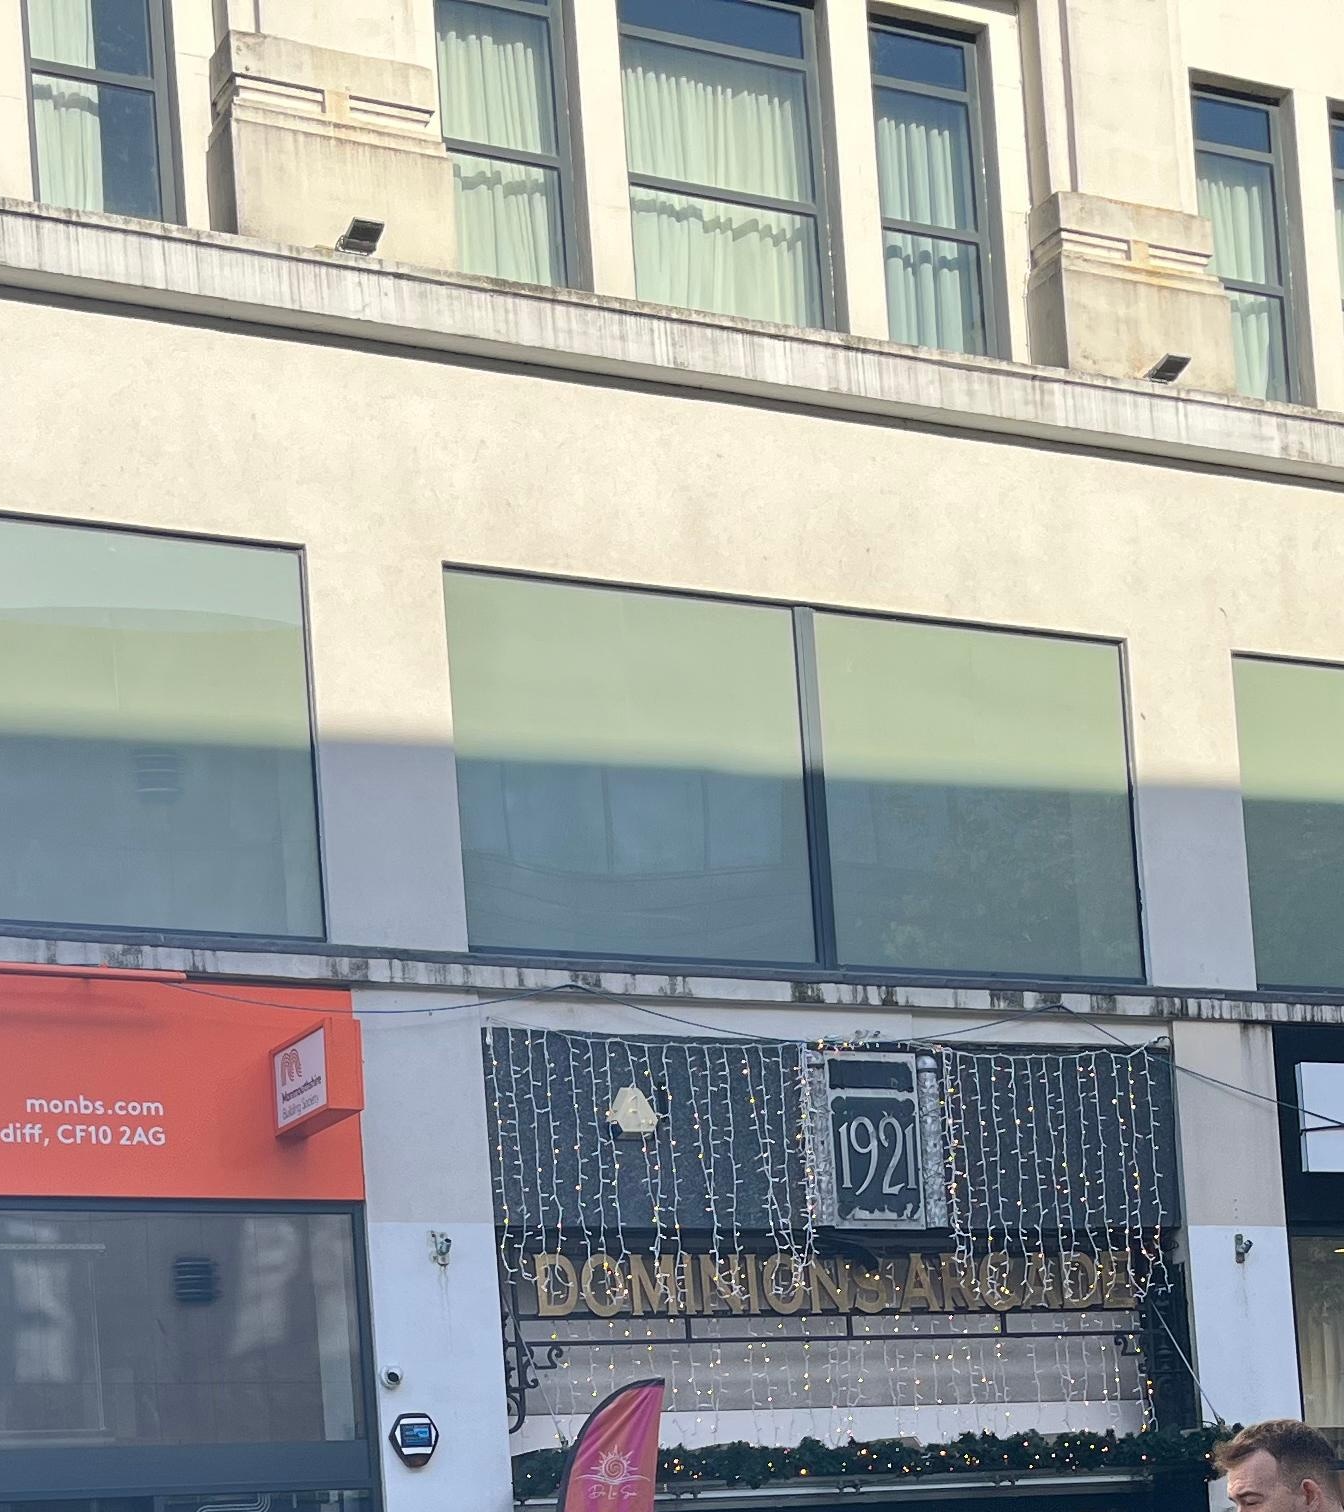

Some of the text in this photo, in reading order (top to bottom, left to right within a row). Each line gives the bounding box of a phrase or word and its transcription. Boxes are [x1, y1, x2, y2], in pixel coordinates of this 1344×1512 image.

[25, 1095, 164, 1116] monbs.com
[57, 1124, 112, 1144] CF10
[119, 1126, 166, 1145] 2AG
[838, 1110, 918, 1196] 1921
[533, 1251, 1139, 1317] DOMINIONS ARCADE
